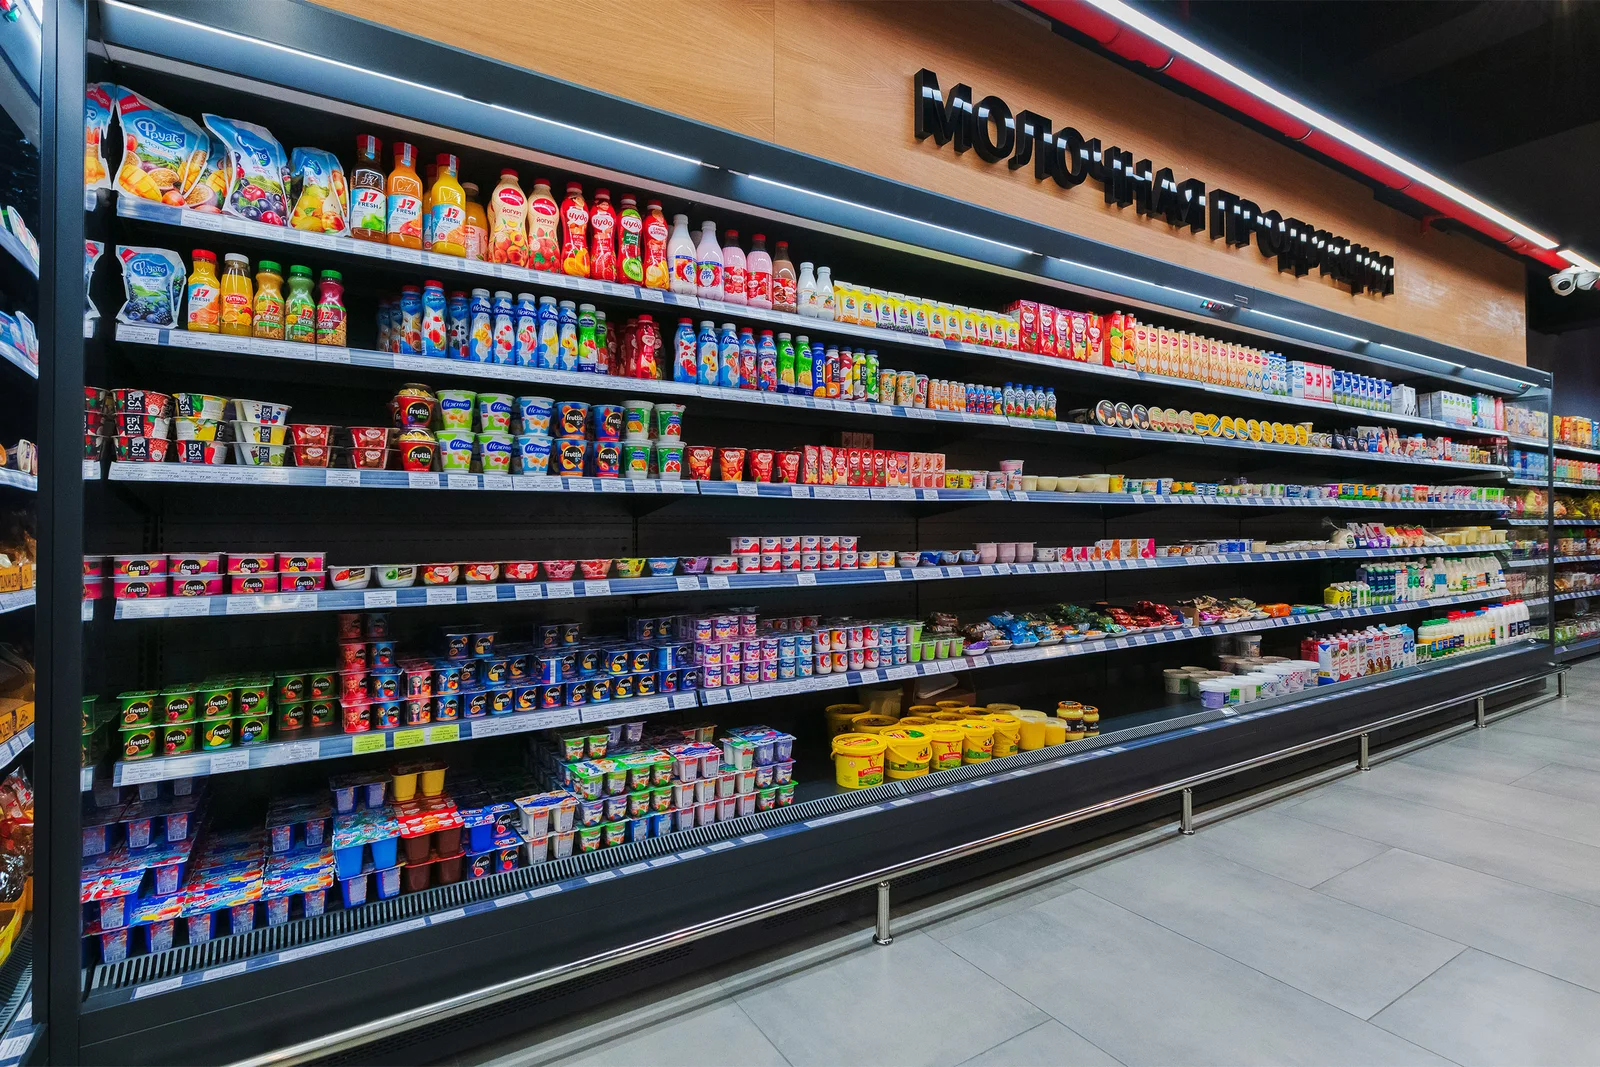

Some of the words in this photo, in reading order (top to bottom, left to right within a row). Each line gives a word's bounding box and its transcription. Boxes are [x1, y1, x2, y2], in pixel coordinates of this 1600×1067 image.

[914, 68, 1205, 234] МОЛОЧНАЯ
[360, 192, 379, 202] J7
[399, 199, 416, 209] J7
[445, 208, 460, 218] J7
[194, 289, 210, 298] J7
[266, 305, 280, 314] J7
[301, 309, 313, 319] J7
